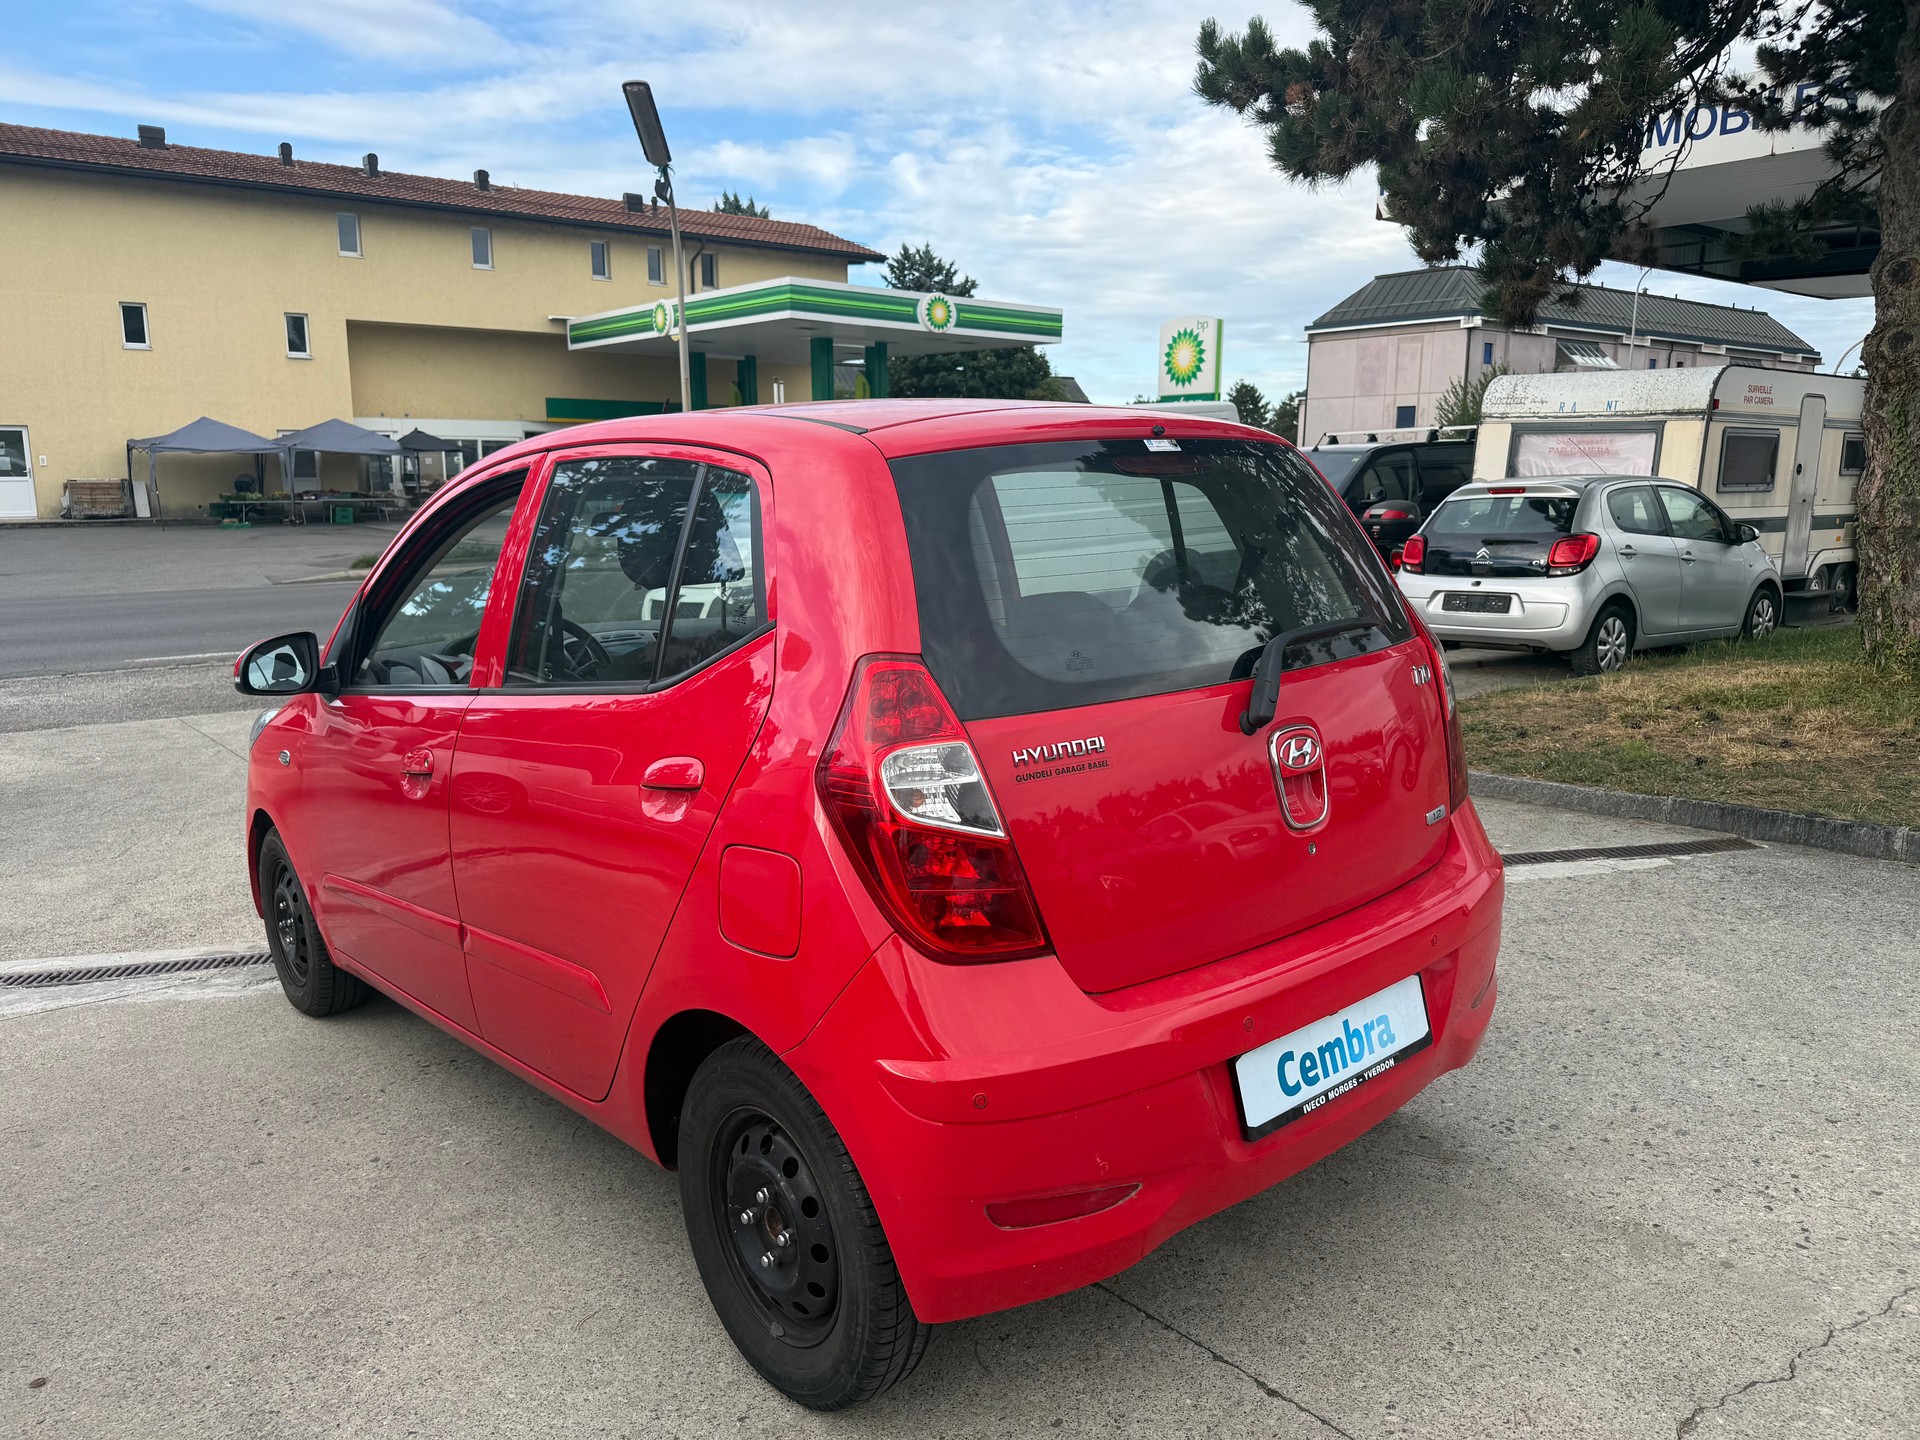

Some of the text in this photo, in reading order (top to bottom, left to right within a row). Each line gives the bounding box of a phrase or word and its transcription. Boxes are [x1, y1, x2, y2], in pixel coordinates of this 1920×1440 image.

[1196, 319, 1209, 333] bp
[1743, 395, 1774, 406] PAR CAMERA
[1012, 735, 1106, 768] HYUNDAI
[1015, 759, 1110, 783] GUNDELI GARAGE BASEL
[1276, 1013, 1396, 1098] Cembra
[1302, 1094, 1326, 1115] IVECO
[1328, 1078, 1358, 1101] MORGES
[1363, 1057, 1395, 1081] YVERDON
